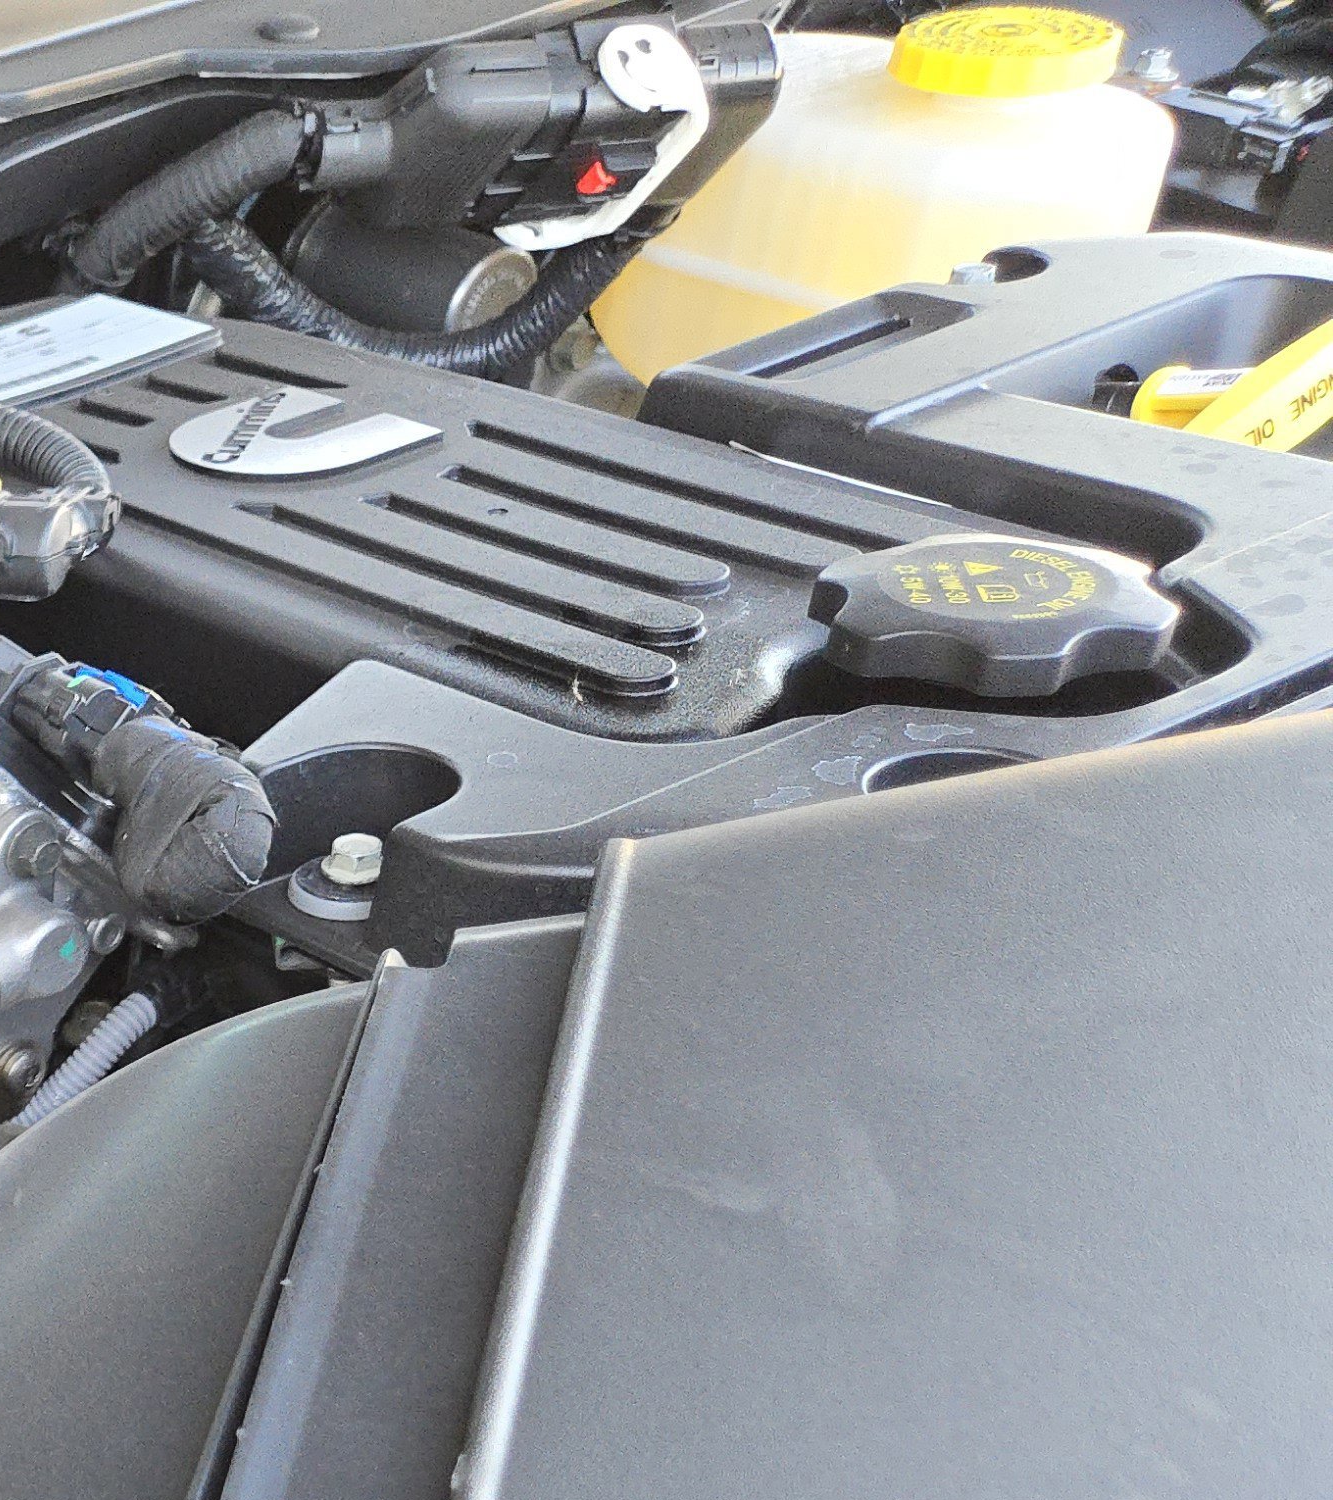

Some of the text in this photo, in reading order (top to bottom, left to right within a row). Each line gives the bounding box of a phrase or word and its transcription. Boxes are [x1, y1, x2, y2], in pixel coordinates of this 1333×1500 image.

[1244, 418, 1275, 447] OIL
[1009, 548, 1078, 573] DIESEL
[900, 576, 932, 605] 5W-40
[1068, 570, 1096, 602] ENGINE
[1036, 598, 1077, 611] OIL
